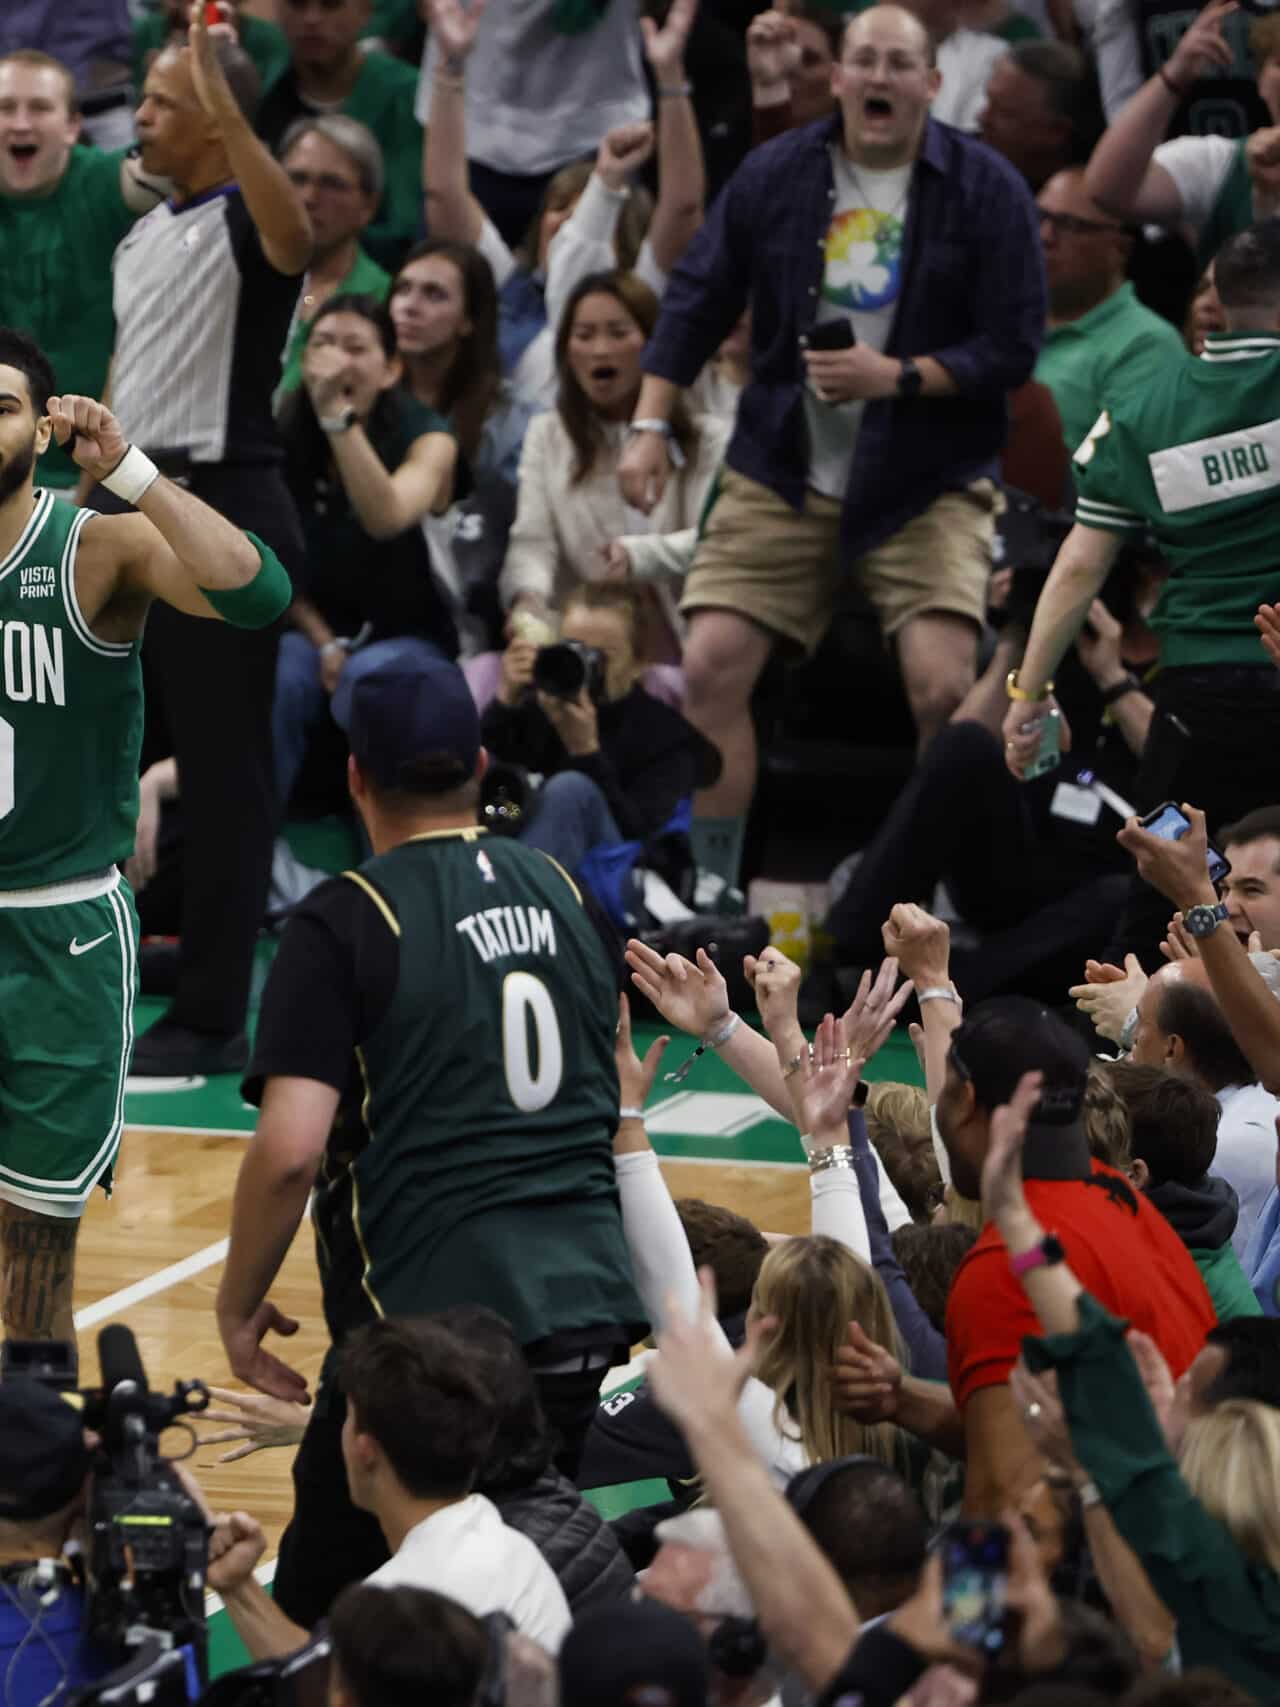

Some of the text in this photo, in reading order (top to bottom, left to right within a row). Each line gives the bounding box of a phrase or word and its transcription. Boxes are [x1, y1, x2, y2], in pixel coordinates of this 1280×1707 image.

[20, 565, 56, 584] VISTA
[20, 583, 56, 599] PRINT
[456, 905, 557, 963] TATUM
[502, 970, 564, 1113] 0
